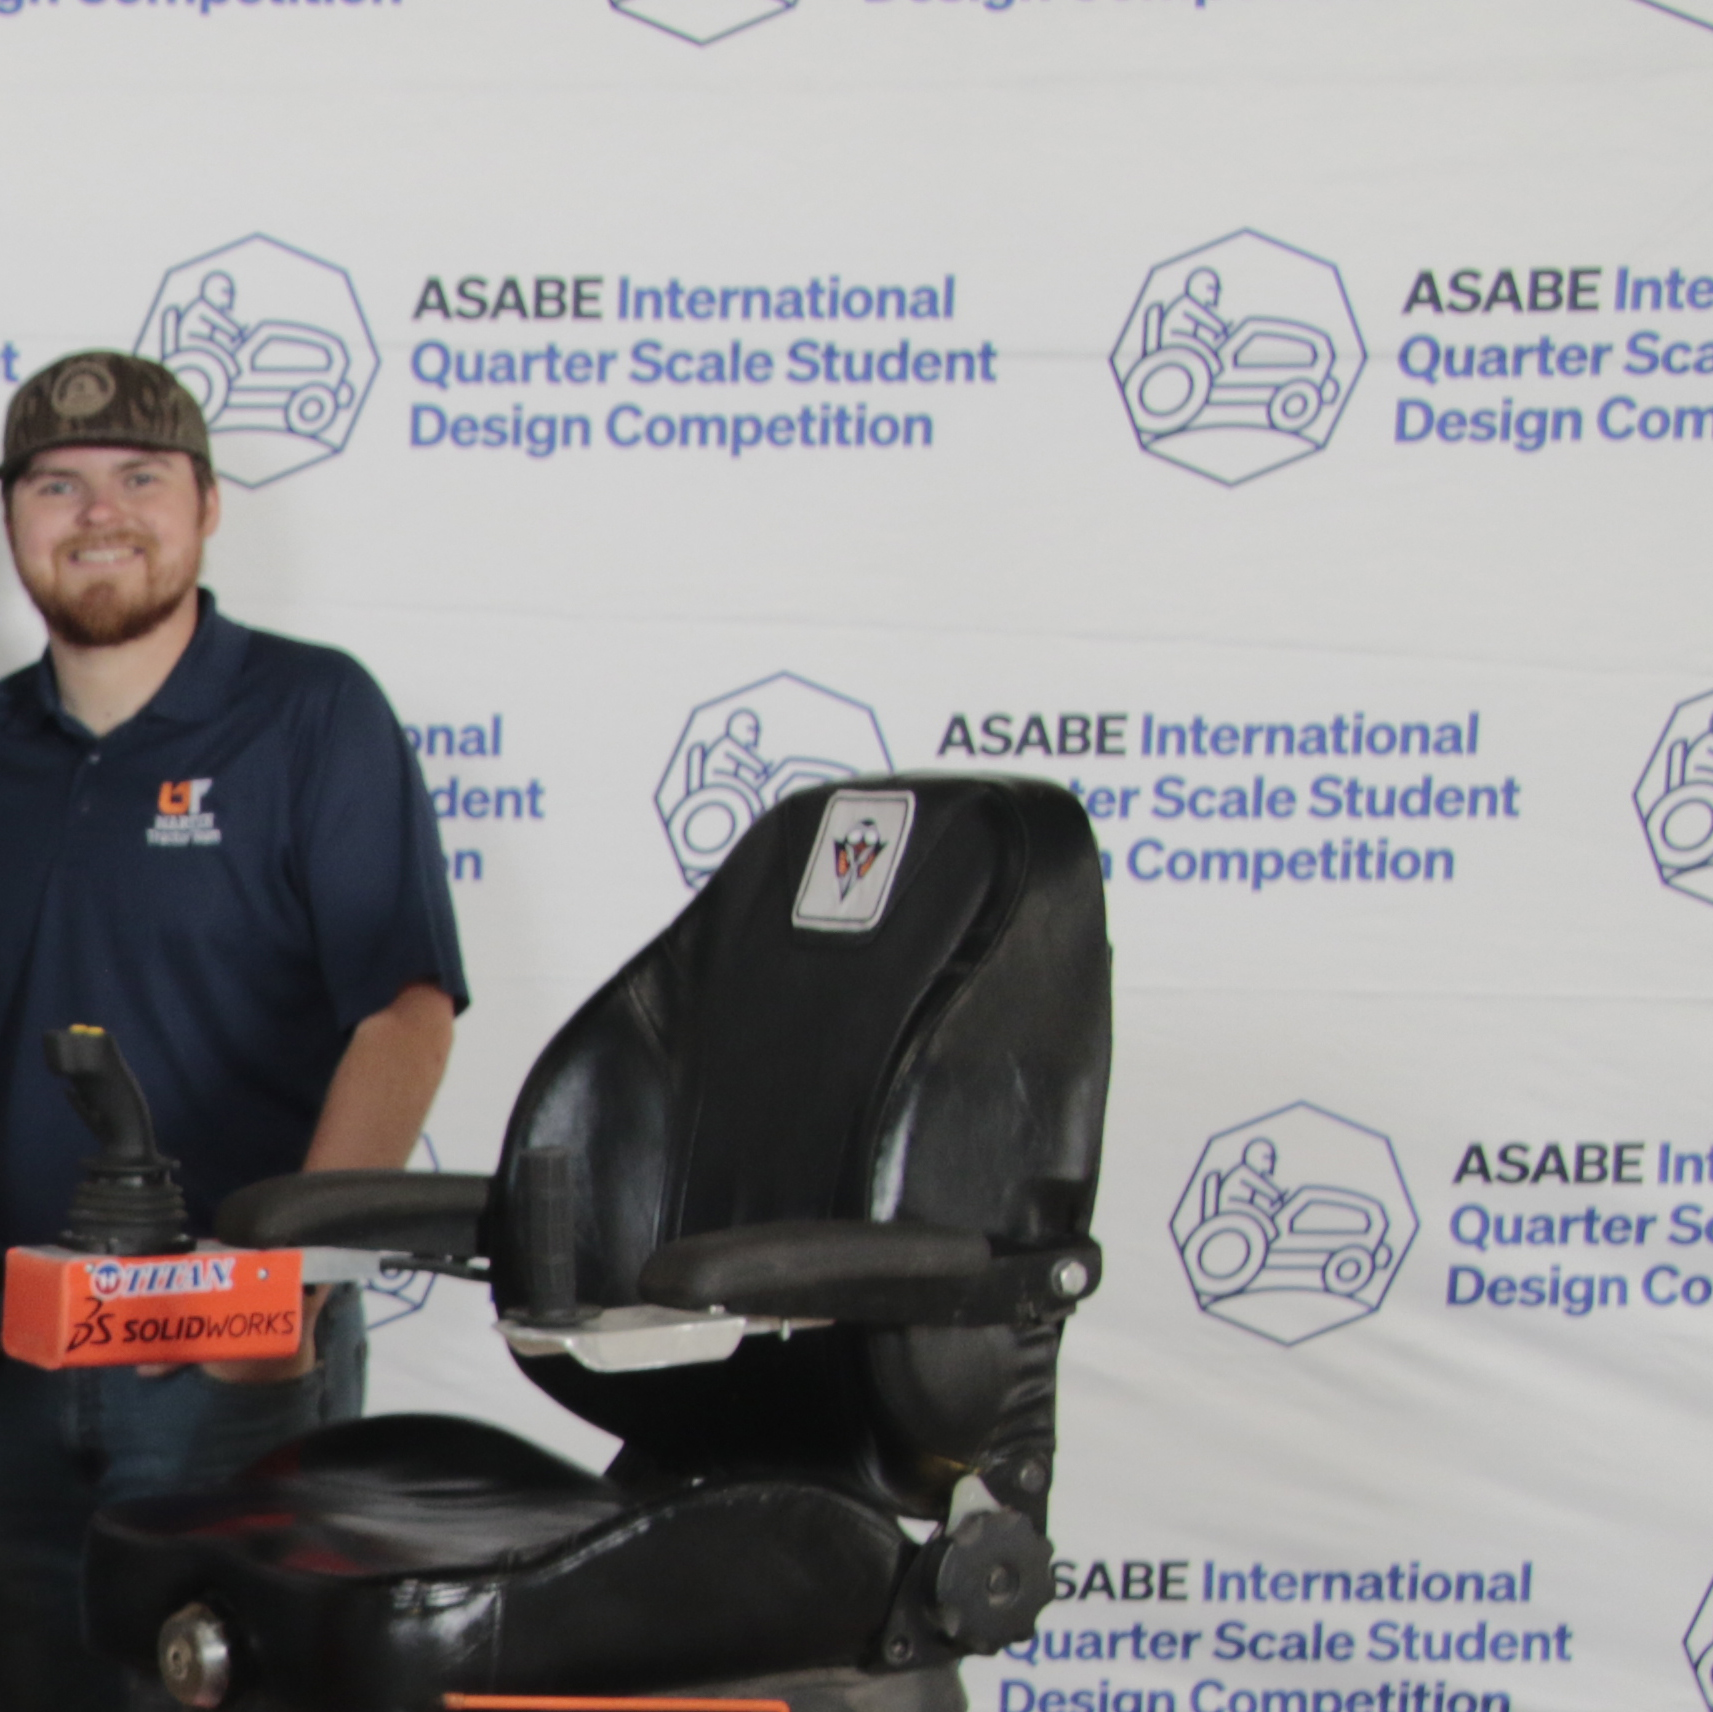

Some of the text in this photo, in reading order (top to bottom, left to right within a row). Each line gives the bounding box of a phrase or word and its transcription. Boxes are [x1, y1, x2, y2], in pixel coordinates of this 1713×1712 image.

[414, 275, 955, 319] ASABE International
[1404, 267, 1602, 313] ASABE
[411, 339, 998, 389] Quarter Scale Student
[1398, 334, 1613, 384] Quarter
[411, 403, 933, 457] Design Competition
[1396, 398, 1583, 452] Design
[938, 712, 1479, 756] ASABE International
[1153, 775, 1297, 818] Scale
[1310, 774, 1520, 818] Student
[1128, 838, 1455, 890] Competition
[1454, 1143, 1644, 1184] ASABE
[1451, 1203, 1657, 1251] Quarter
[116, 1259, 235, 1297] TITAN
[1447, 1265, 1628, 1316] Design
[122, 1310, 296, 1345] SOLIDWORKS
[1049, 1561, 1532, 1602] SABE International
[1214, 1621, 1355, 1661] Scale
[1368, 1621, 1573, 1662] Student
